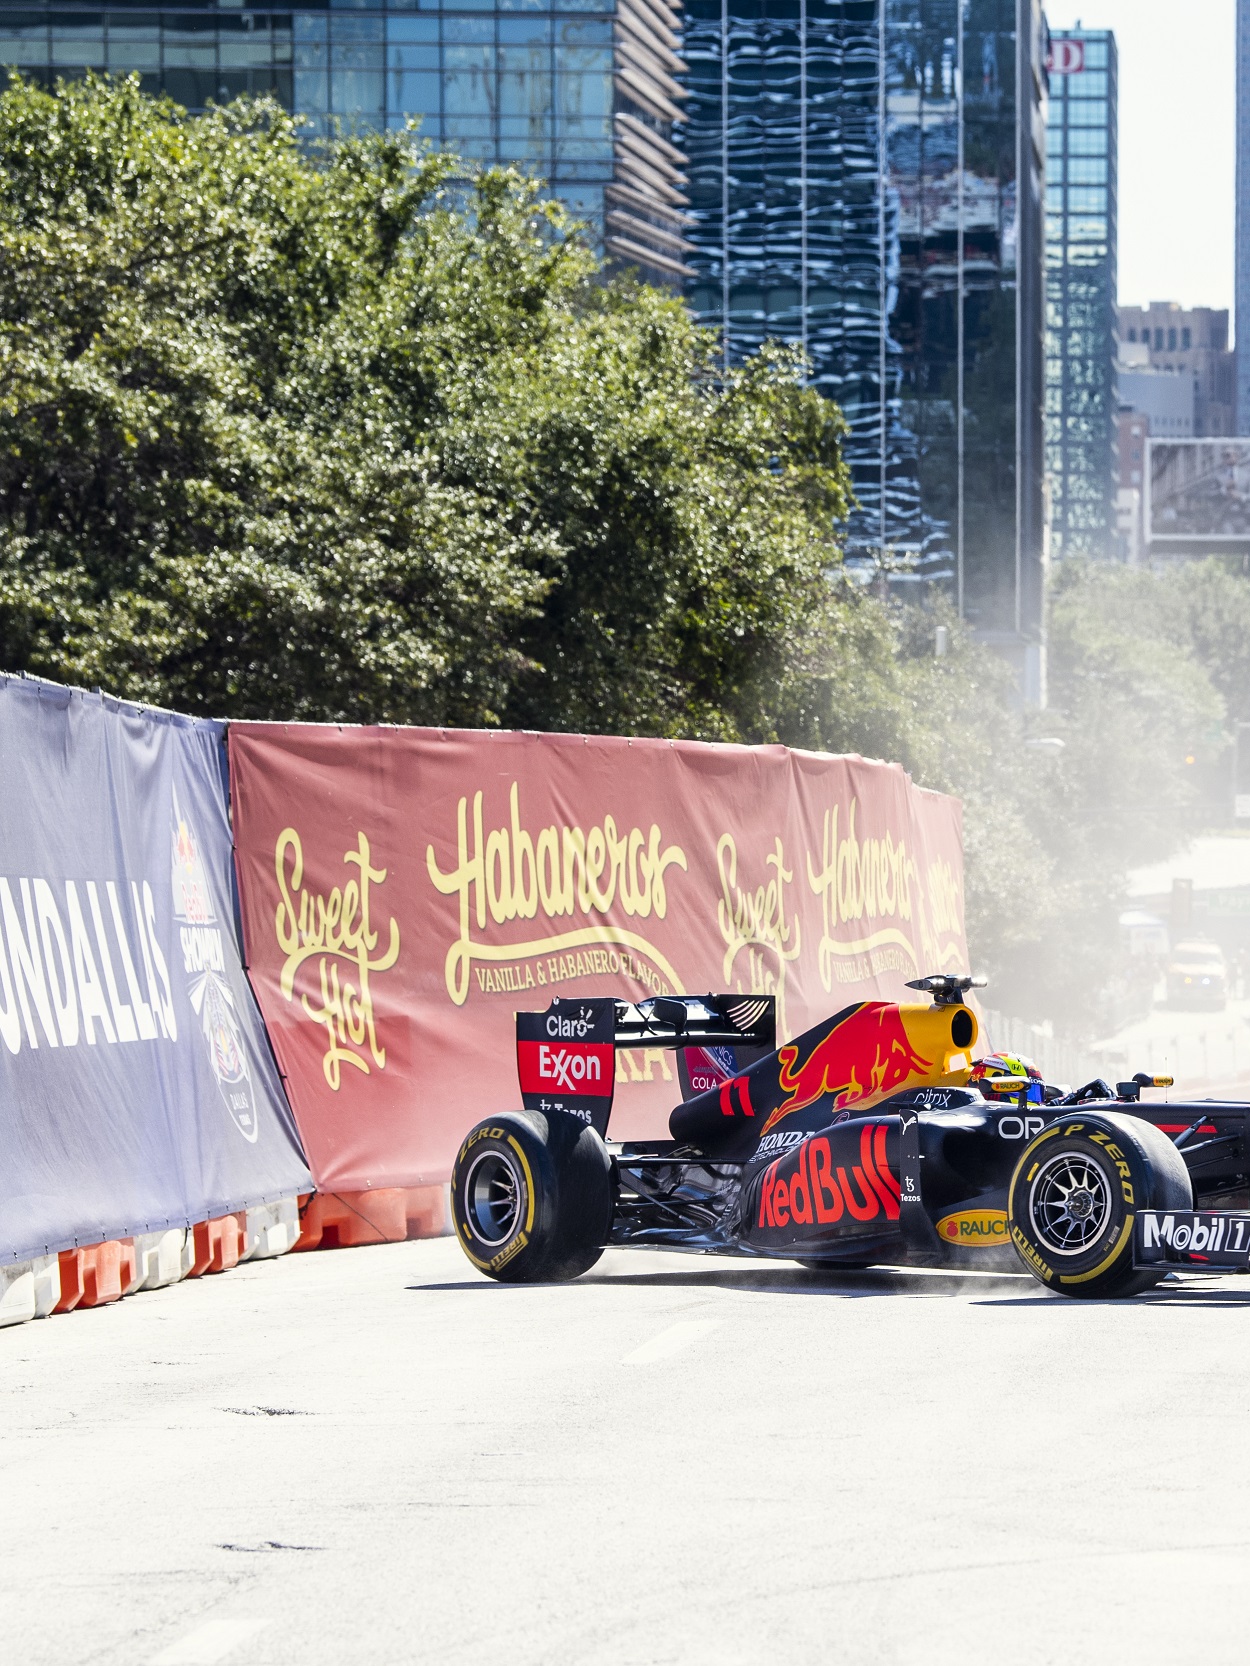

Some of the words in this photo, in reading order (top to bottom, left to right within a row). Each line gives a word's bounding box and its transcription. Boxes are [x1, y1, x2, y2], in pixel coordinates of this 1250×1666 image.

[275, 827, 388, 956] Sweet
[426, 781, 688, 960] Habaneros
[716, 833, 794, 944] Sweet
[474, 964, 537, 993] VANILLA
[536, 961, 549, 985] &
[547, 949, 621, 983] HABANERO
[281, 930, 400, 1091] Hot
[546, 1015, 588, 1037] Claro
[539, 1045, 601, 1091] Exxon
[692, 1077, 717, 1090] COLA
[718, 1076, 755, 1117] 11
[913, 1089, 952, 1108] citrix
[459, 1127, 505, 1165] ZERO
[1064, 1124, 1085, 1136] P
[1089, 1130, 1135, 1205] ZERO
[901, 1193, 921, 1202] Tezos
[1143, 1213, 1225, 1252] Mobil
[1233, 1221, 1246, 1249] 1
